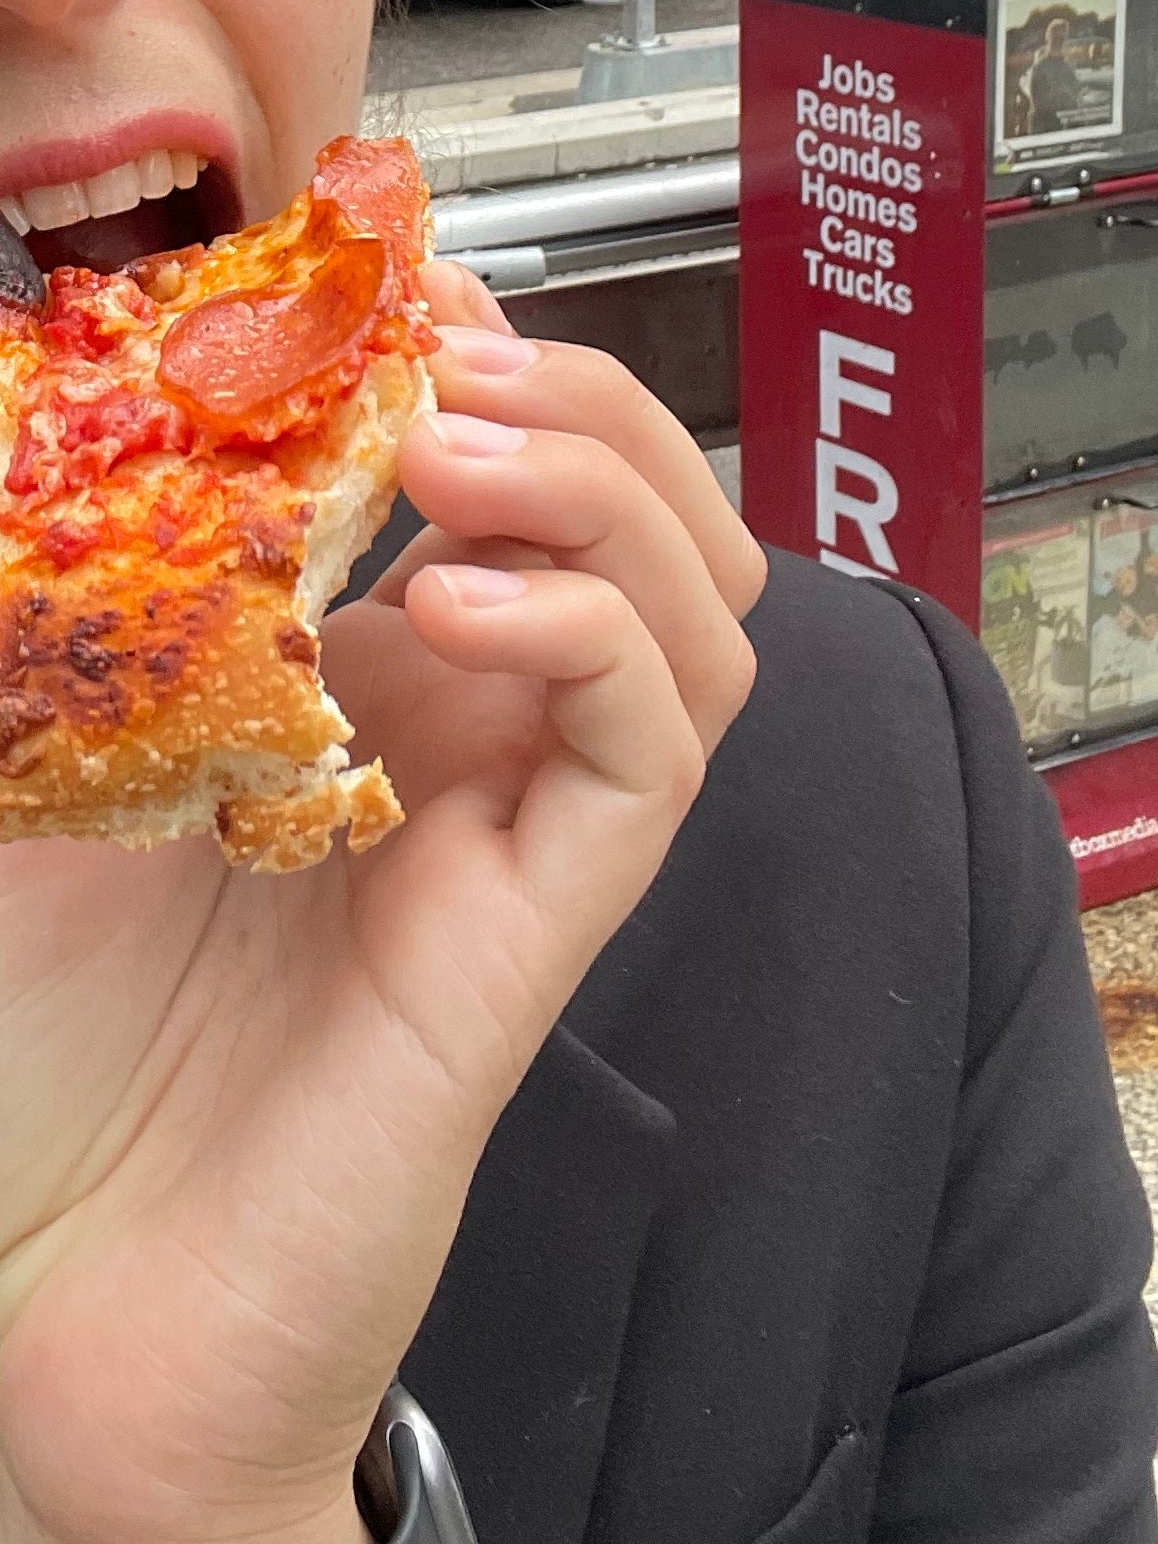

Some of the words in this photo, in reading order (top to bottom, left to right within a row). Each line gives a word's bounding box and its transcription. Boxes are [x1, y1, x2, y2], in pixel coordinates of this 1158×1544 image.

[818, 54, 895, 103] Jobs
[796, 87, 922, 151] Rentals
[795, 128, 922, 193] Condos
[801, 169, 918, 234] Homes
[820, 215, 896, 269] Cars
[802, 248, 913, 315] Trucks
[815, 329, 900, 580] FR
